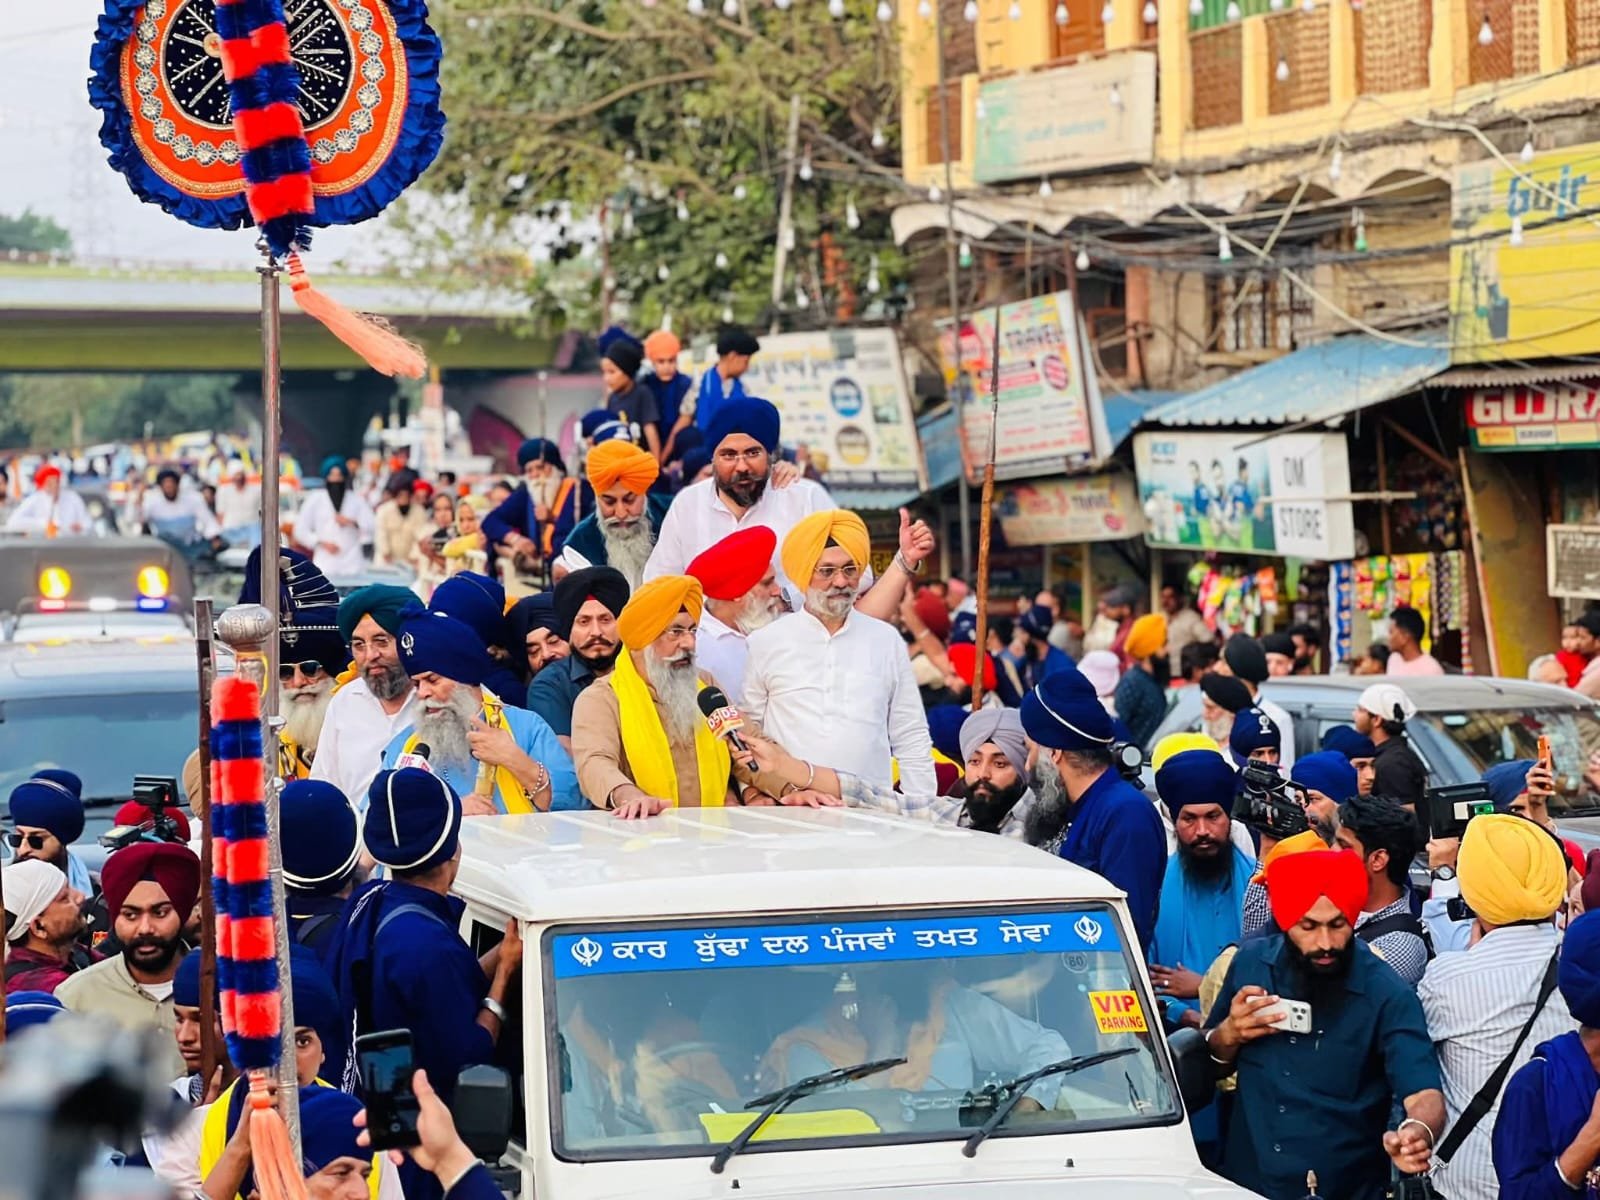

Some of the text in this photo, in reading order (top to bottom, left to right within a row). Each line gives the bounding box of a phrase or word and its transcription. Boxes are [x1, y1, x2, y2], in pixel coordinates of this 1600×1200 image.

[1279, 507, 1323, 540] STORE
[611, 919, 1052, 962] ਕਾਰ ਬੁੱਢਾ ਦਲ ਪੰਜਵਾਂ ਤਖਤ ਸੇਵਾ
[1095, 995, 1136, 1013] VIP
[1101, 1015, 1143, 1029] PARKING
